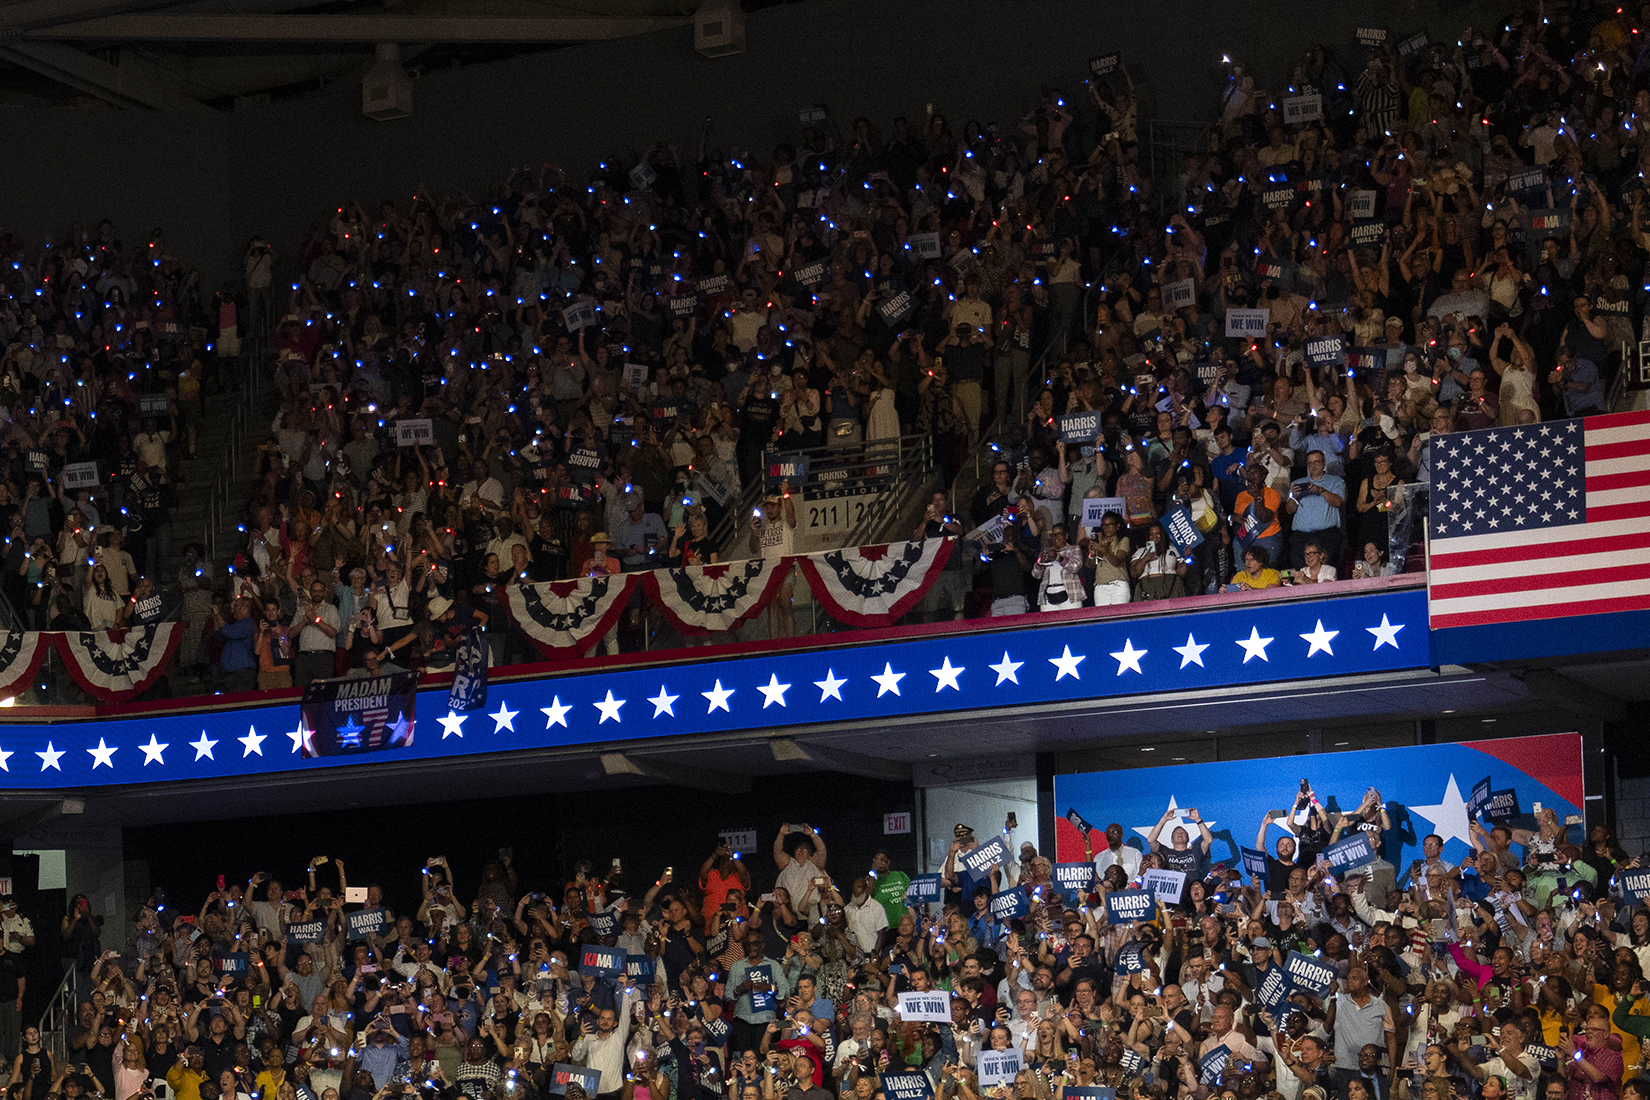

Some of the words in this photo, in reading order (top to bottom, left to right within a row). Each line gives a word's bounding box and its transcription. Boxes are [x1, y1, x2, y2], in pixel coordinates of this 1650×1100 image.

[1357, 27, 1386, 40] HARRIS
[1360, 38, 1380, 47] WALZ
[1091, 55, 1117, 71] HARRIS
[1096, 66, 1114, 75] WALZ
[1510, 178, 1522, 191] WE
[1524, 174, 1543, 188] WIN
[1263, 189, 1294, 204] HARRIS
[1268, 199, 1289, 209] WALZ
[1352, 224, 1384, 238] HARRIS
[1357, 235, 1378, 244] WALZ
[794, 264, 823, 281] HARRIS
[700, 276, 728, 288] HARRIS
[802, 275, 822, 286] WALZ
[706, 286, 725, 294] WALZ
[670, 297, 697, 309] HARRIS
[882, 291, 910, 316] HARRIS
[891, 302, 911, 319] WALZ
[1596, 297, 1629, 312] HARRIS
[1231, 318, 1244, 329] WE
[1249, 318, 1264, 329] WIN
[1307, 339, 1342, 355] HARRIS
[1313, 351, 1337, 362] WALZ
[1062, 416, 1097, 432] HARRIS
[1068, 429, 1092, 439] WALZ
[67, 473, 78, 483] WE
[80, 471, 95, 481] WIN
[770, 463, 804, 477] KAMALA
[816, 486, 878, 500] SECTION
[810, 505, 837, 527] 211
[1088, 508, 1101, 520] WE
[1168, 522, 1185, 546] WALZ
[1170, 510, 1197, 545] HARRIS
[136, 595, 162, 615] HARRIS
[140, 608, 160, 619] WALZ
[336, 679, 391, 698] MADAM
[335, 696, 388, 712] PRESIDENT
[889, 816, 906, 831] EXIT
[966, 842, 1003, 870] HARRIS
[1329, 852, 1347, 867] WE
[1347, 845, 1366, 862] WIN
[978, 857, 1002, 872] WALZ
[1057, 867, 1093, 882] HARRIS
[1064, 881, 1087, 889] WALZ
[1147, 881, 1159, 892] WE
[1161, 883, 1178, 895] WIN
[1110, 895, 1150, 911] HARRIS
[350, 913, 383, 928] HARRIS
[996, 908, 1016, 919] WALZ
[1119, 909, 1145, 919] WALZ
[290, 922, 322, 935] HARRIS
[295, 931, 318, 939] WALZ
[358, 924, 380, 934] WALZ
[584, 952, 622, 969] KAMALA
[1289, 958, 1333, 986] HARRIS
[1258, 969, 1282, 1007] HARRIS
[1293, 975, 1322, 992] WALZ
[1269, 983, 1287, 1007] WALZ
[905, 1002, 921, 1014] WE
[923, 1002, 945, 1014] WIN
[984, 1063, 998, 1076] WE
[999, 1061, 1020, 1075] WIN
[885, 1075, 926, 1090] HARRIS
[895, 1089, 923, 1098] WALZ
